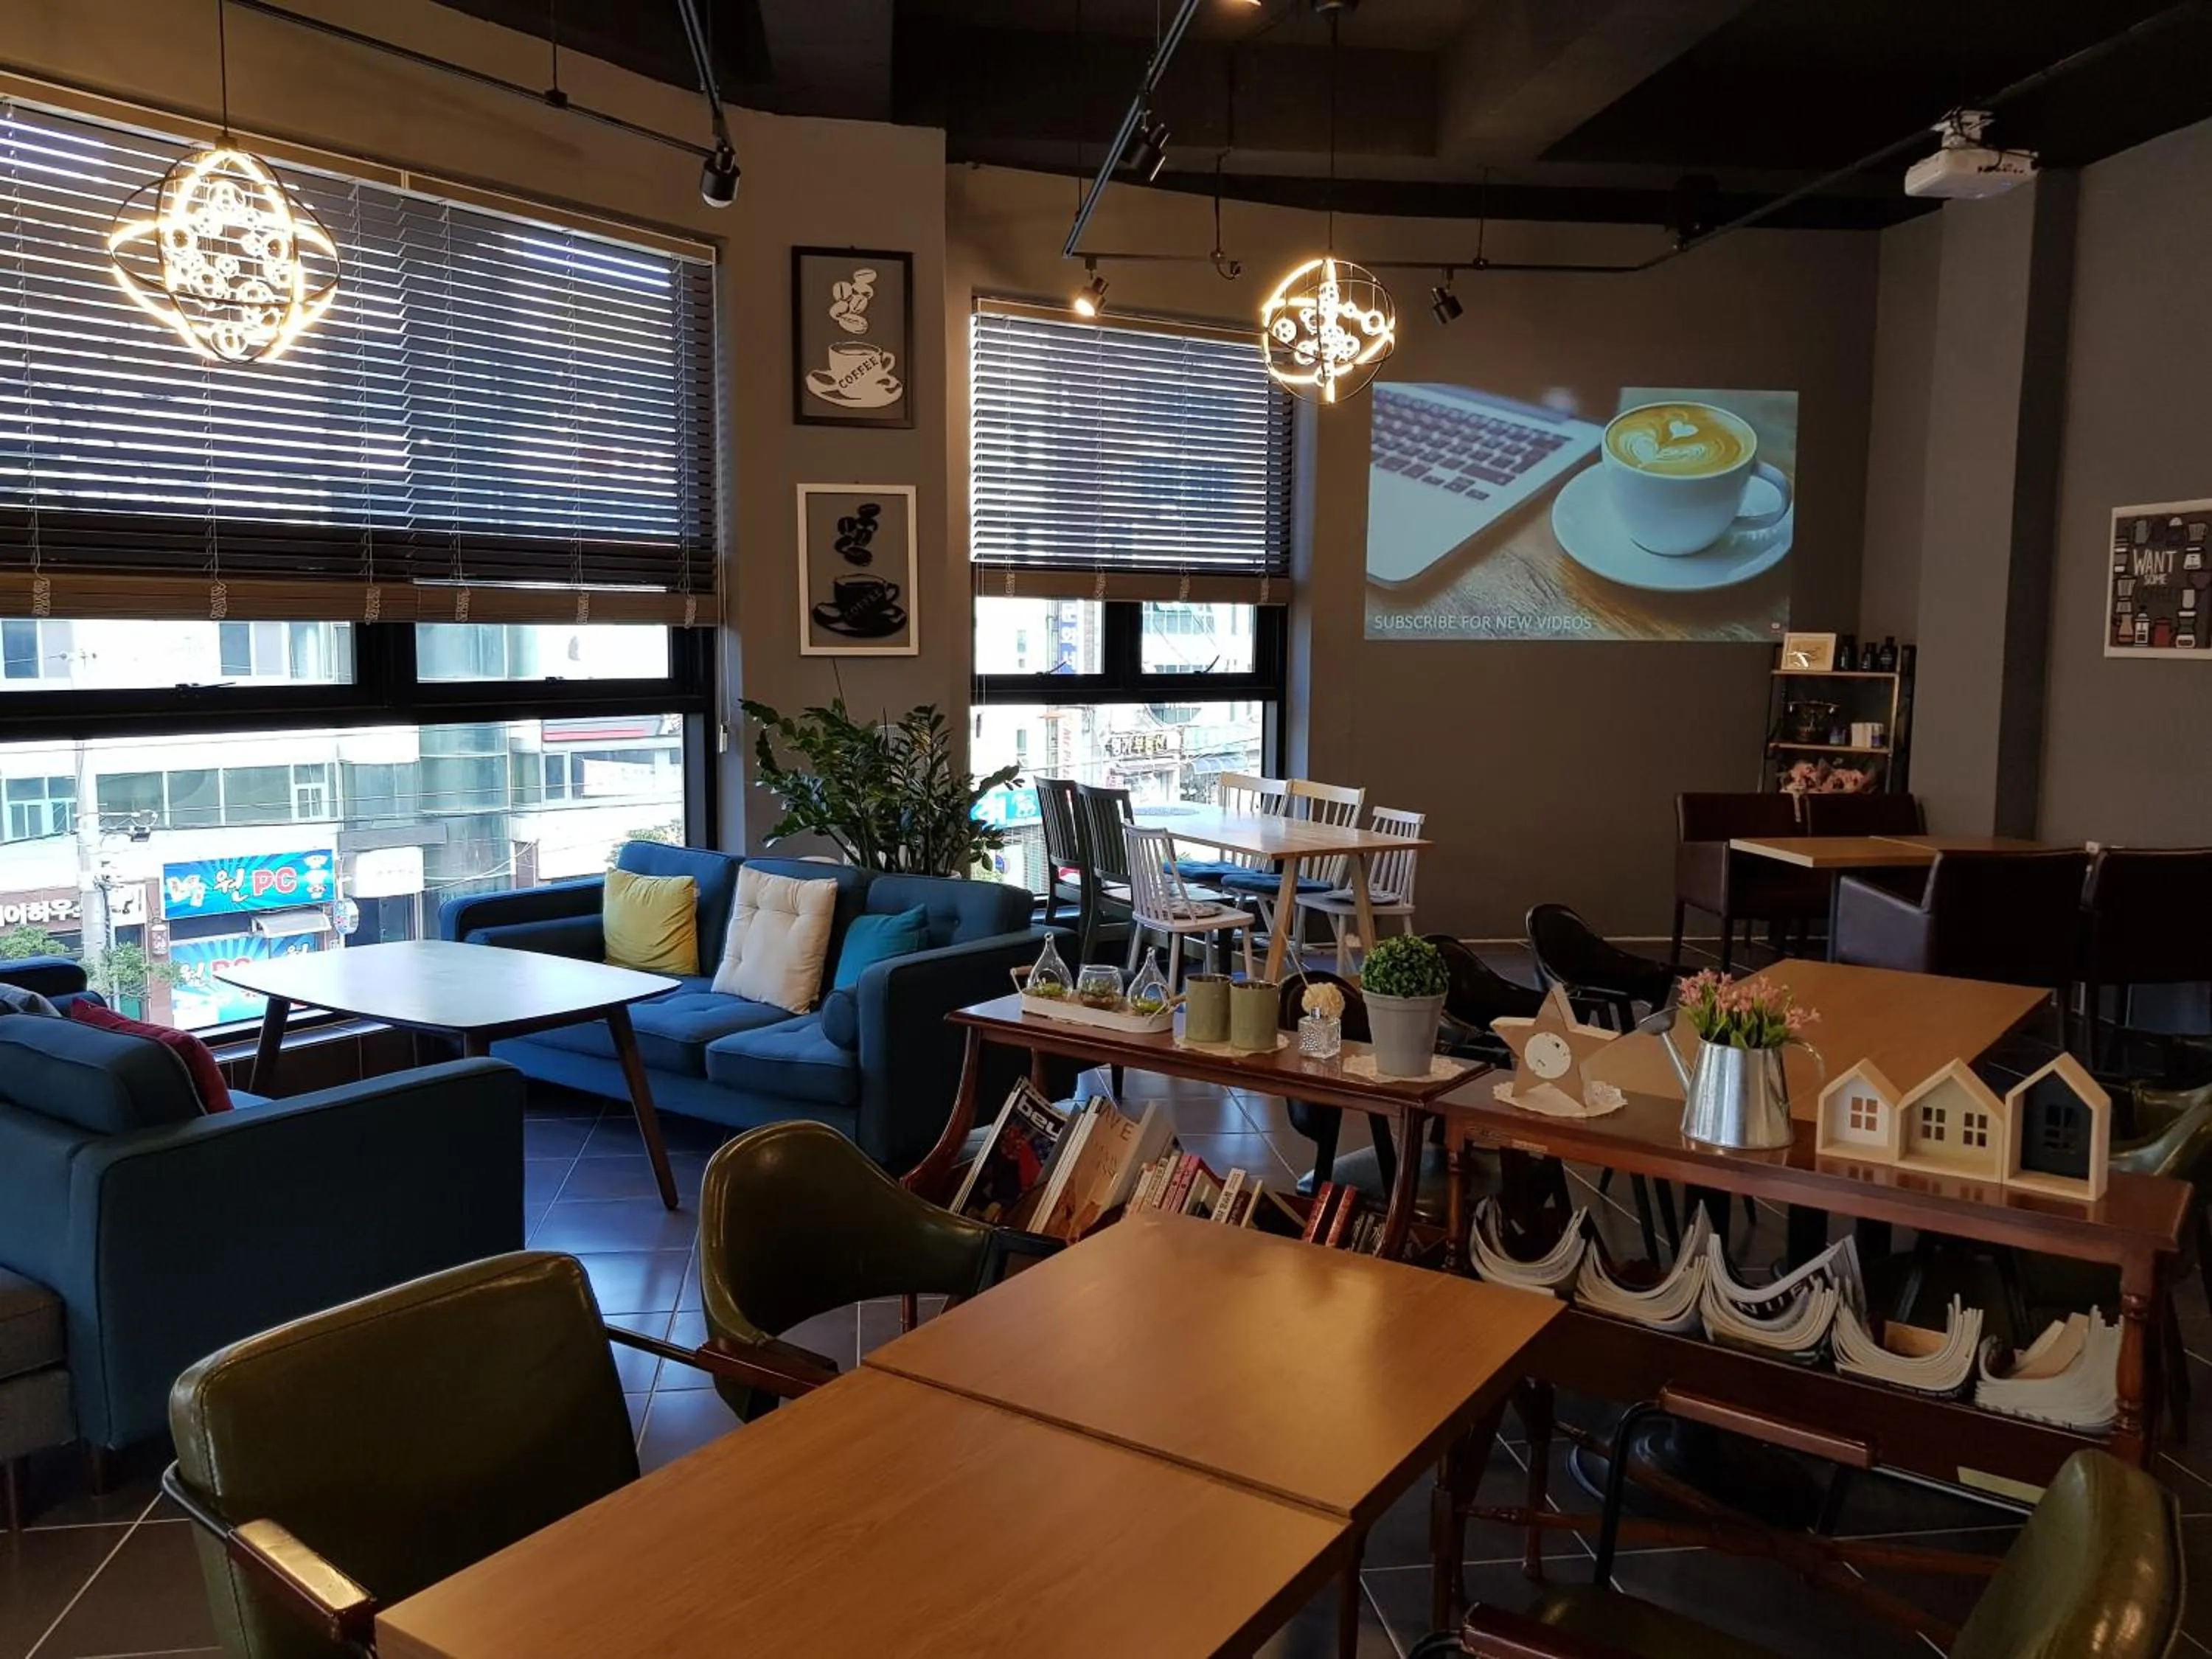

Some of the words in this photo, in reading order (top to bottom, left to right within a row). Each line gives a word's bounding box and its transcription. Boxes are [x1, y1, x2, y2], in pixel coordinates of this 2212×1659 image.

[839, 355, 879, 389] COFFEE
[2133, 548, 2177, 576] WANT
[1374, 615, 1455, 630] SUBSCRIBE
[1461, 616, 1492, 629] FOR
[1496, 616, 1532, 629] NEW
[1537, 616, 1592, 630] VIDEOS
[252, 866, 297, 896] PC
